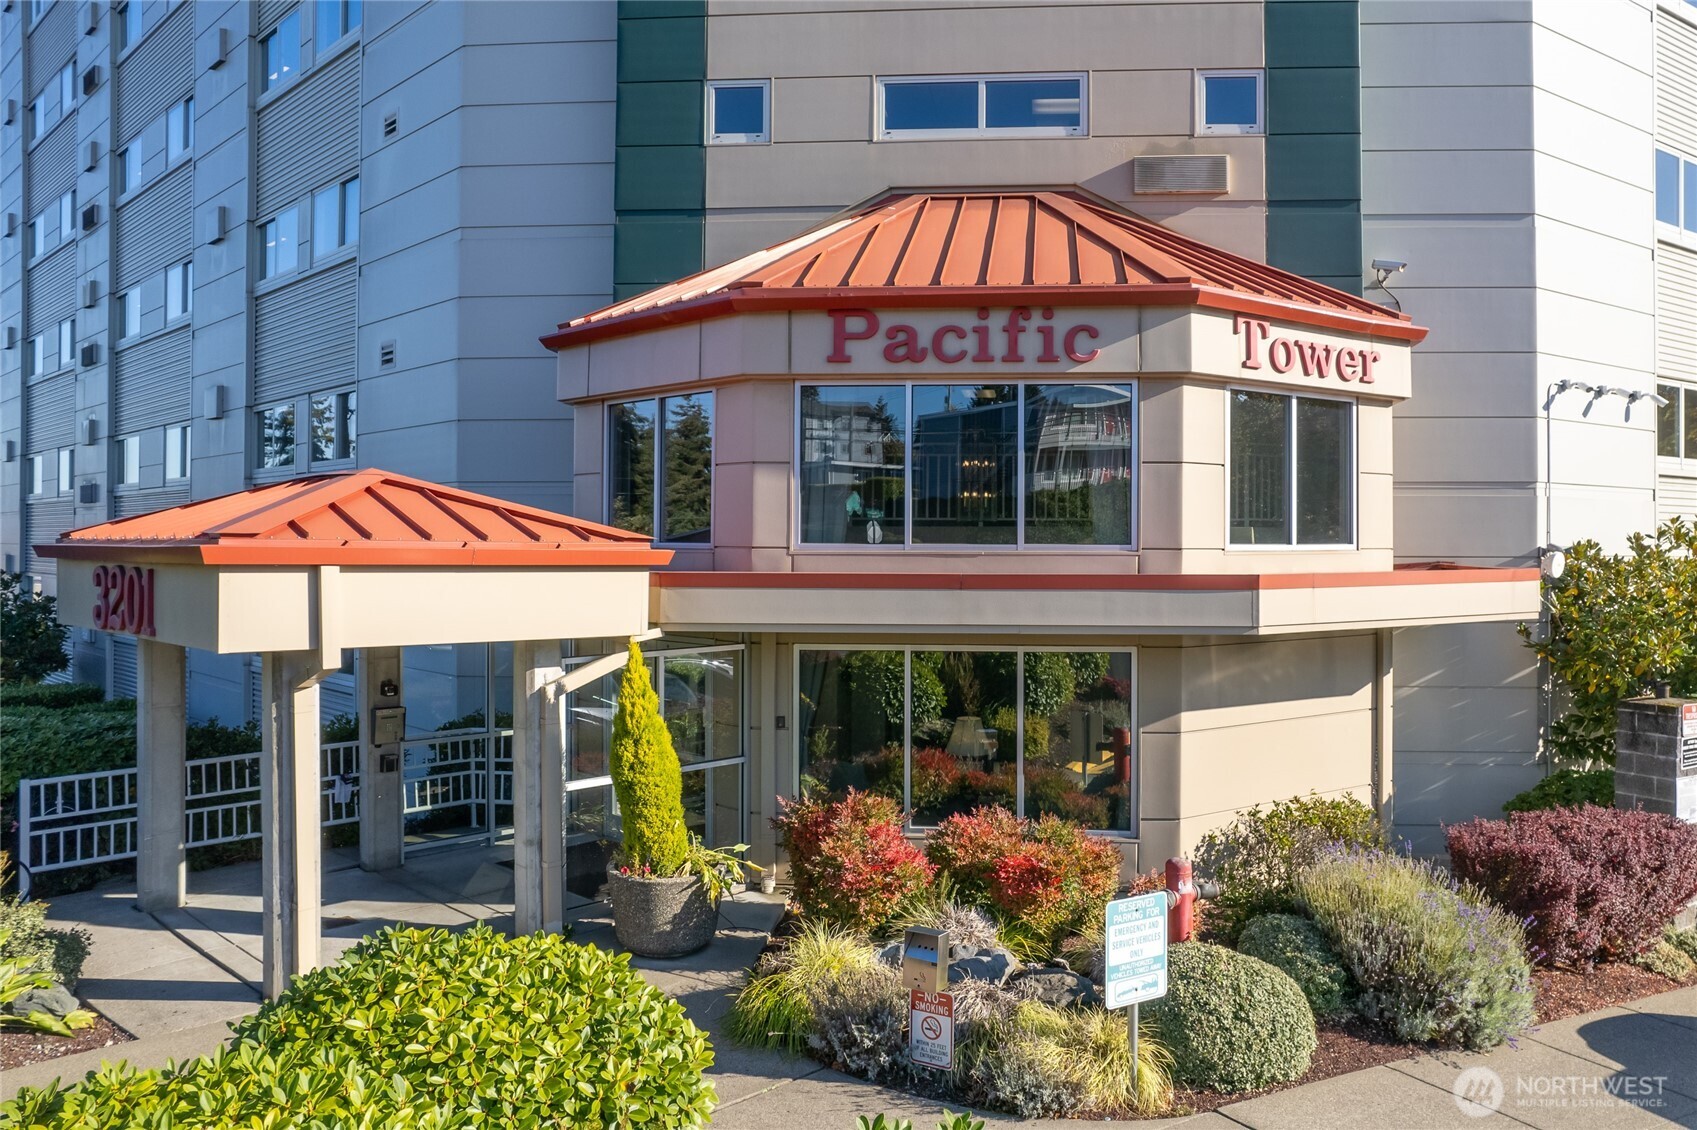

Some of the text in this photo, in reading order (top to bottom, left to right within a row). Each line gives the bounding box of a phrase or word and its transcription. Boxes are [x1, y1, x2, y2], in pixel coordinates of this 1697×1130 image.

[826, 306, 1381, 384] Pacific Tower
[92, 565, 156, 637] 3201
[1118, 898, 1155, 913] RESERVED
[1113, 907, 1160, 925] PARKING FOR
[1114, 920, 1159, 937] EMERGENCY AND
[1112, 932, 1161, 950] SERVICE VEHICLES
[1129, 948, 1143, 959] ONLY
[1111, 963, 1162, 980] VEHICLES TOWED AWAY
[1119, 958, 1154, 971] UNAUTHORIZED
[924, 992, 939, 1004] NO
[915, 1001, 949, 1016] SMOKING
[920, 1052, 943, 1062] ENTRANCES
[930, 1048, 949, 1057] BUILDING
